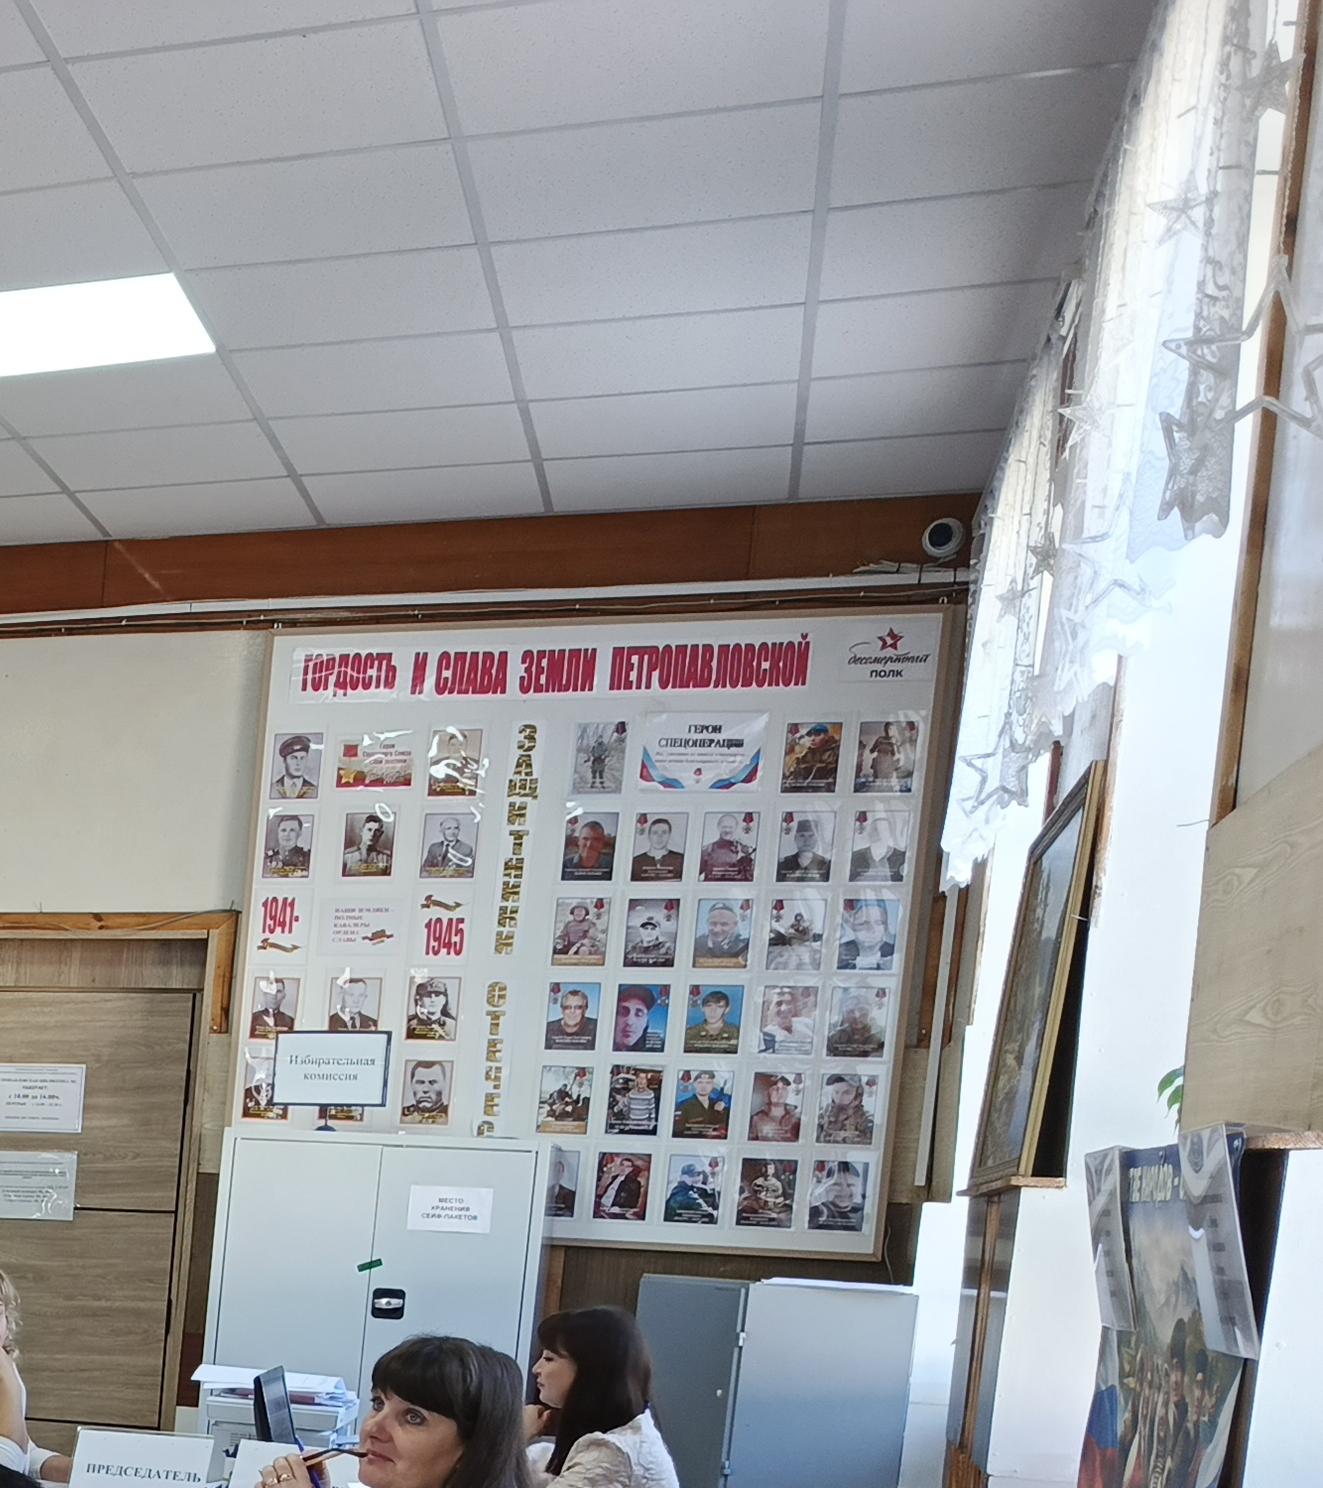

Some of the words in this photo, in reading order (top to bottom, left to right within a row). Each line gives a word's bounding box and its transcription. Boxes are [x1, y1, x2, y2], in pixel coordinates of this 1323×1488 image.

[301, 652, 397, 697] ГОРДОСТЬ
[410, 652, 429, 695] И
[434, 651, 509, 695] СЛАВА
[519, 648, 597, 694] ЗЕМЛИ
[608, 633, 811, 690] ПЕТРОПАВЛОВСКОЙ
[869, 669, 904, 678] ПОЛК
[261, 896, 300, 935] 1941-
[424, 917, 466, 957] 1945
[289, 1054, 376, 1068] Избирательная
[303, 1073, 358, 1082] комиссия
[421, 1212, 478, 1221] СЕЙФ-ПАКЕТОВ
[85, 1463, 202, 1483] ПРЕДСЕДАТЕЛЬ
